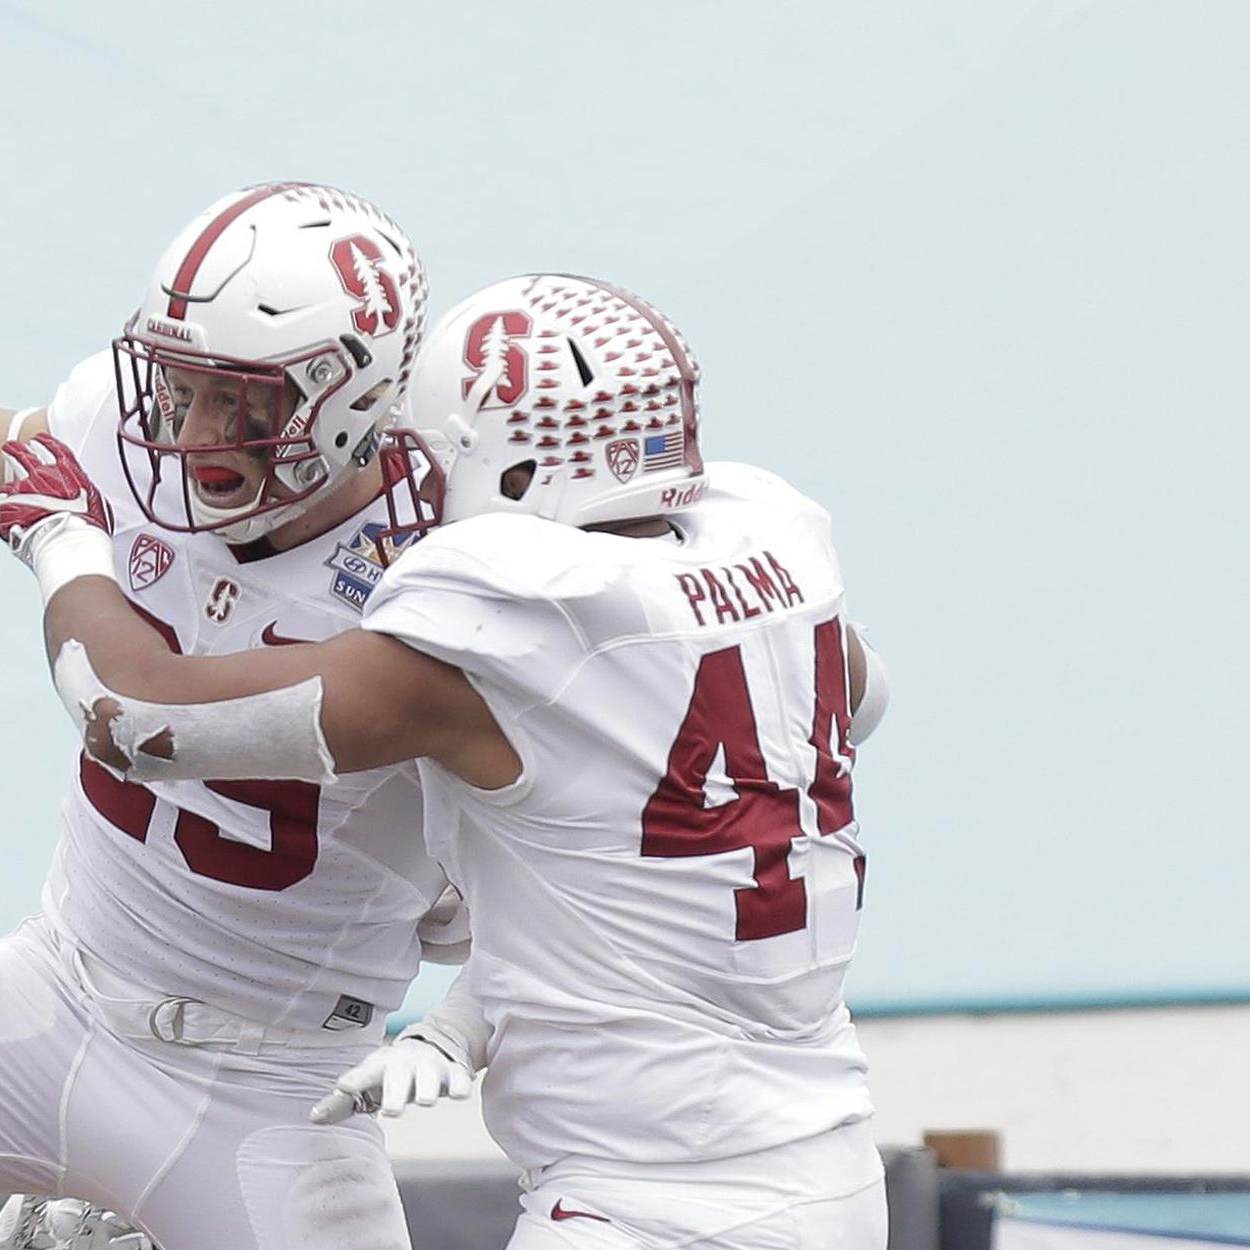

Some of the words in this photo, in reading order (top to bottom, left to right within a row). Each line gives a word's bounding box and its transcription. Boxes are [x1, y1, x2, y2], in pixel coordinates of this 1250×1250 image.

[131, 557, 155, 583] 12
[335, 580, 366, 602] SUN
[675, 551, 805, 627] PALMA
[640, 615, 867, 942] 44
[344, 1003, 361, 1019] 42
